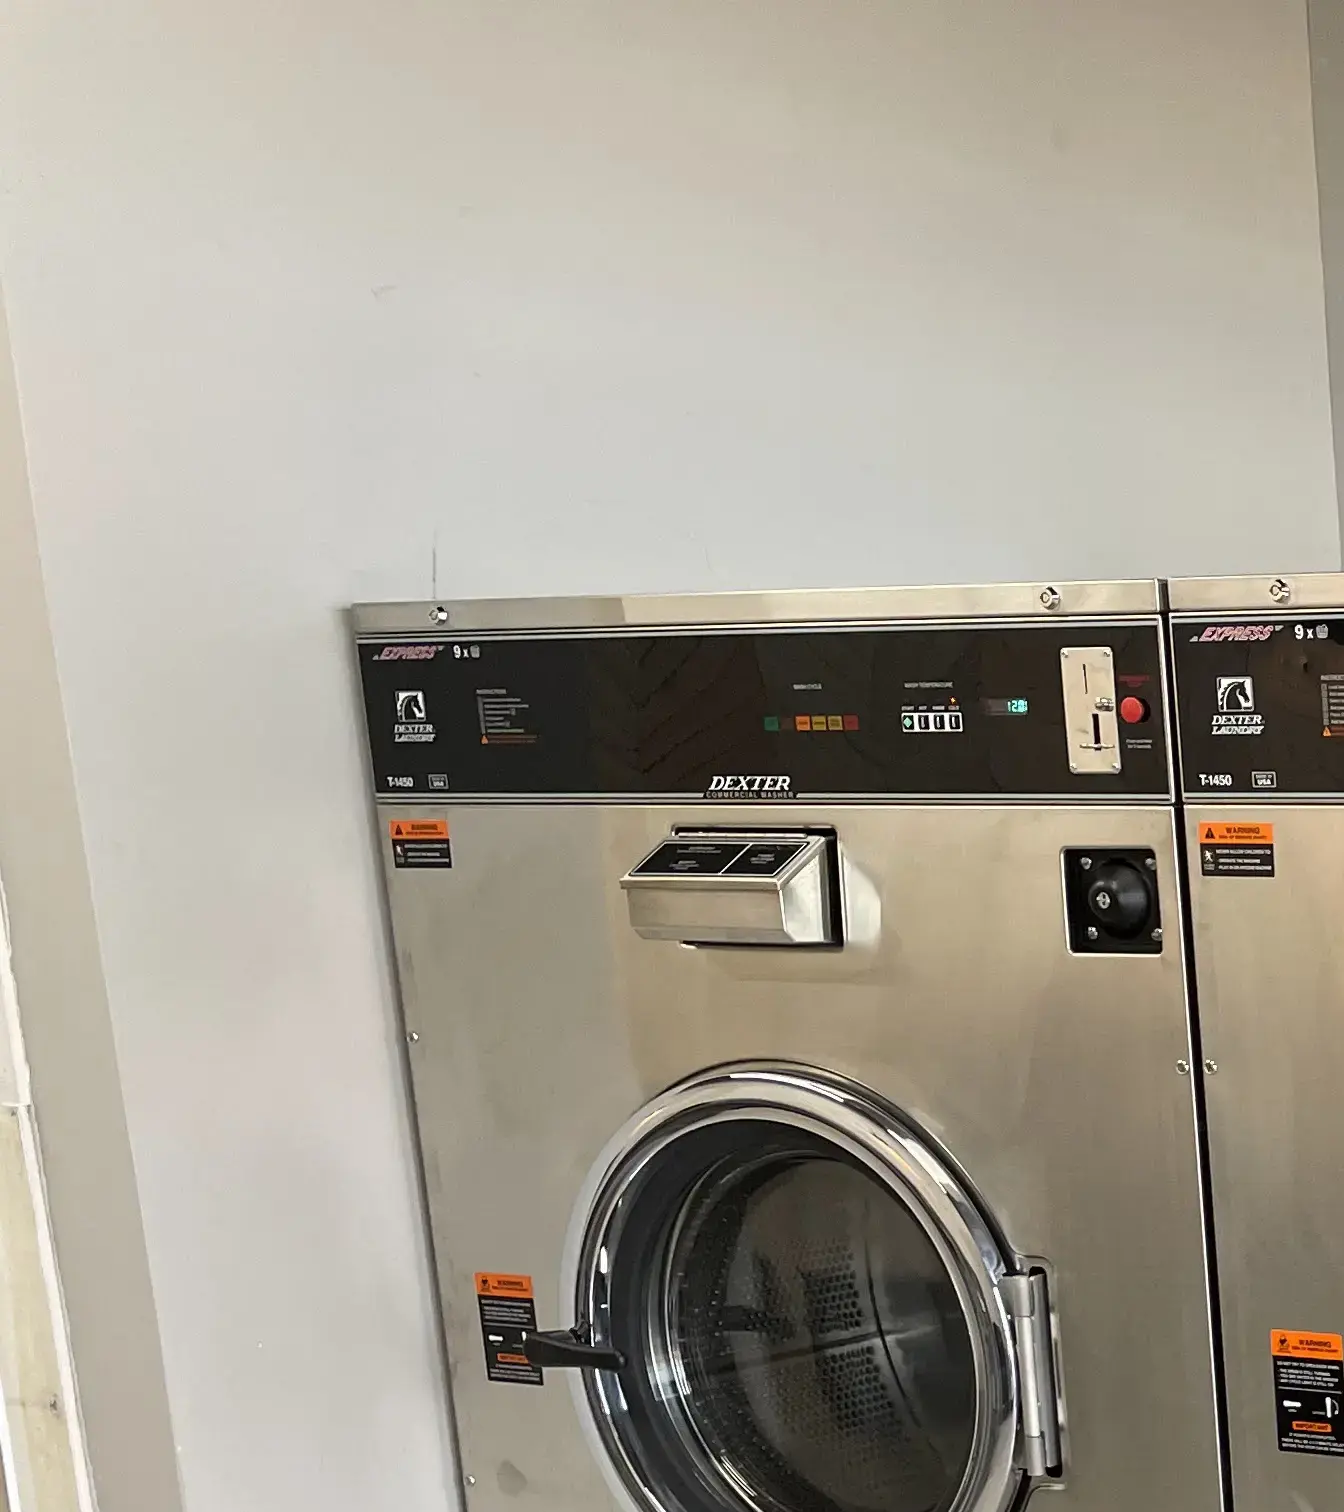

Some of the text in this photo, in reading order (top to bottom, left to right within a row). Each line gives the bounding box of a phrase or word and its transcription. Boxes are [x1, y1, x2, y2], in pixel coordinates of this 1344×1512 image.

[1199, 625, 1274, 641] EXPRESS
[1294, 624, 1304, 639] 9
[453, 645, 461, 659] 9
[1212, 715, 1262, 725] DEXTER
[394, 724, 434, 733] DEXTER
[708, 775, 791, 791] DEXTER
[1199, 774, 1232, 786] T-1450
[1299, 1340, 1331, 1349] WARNING
